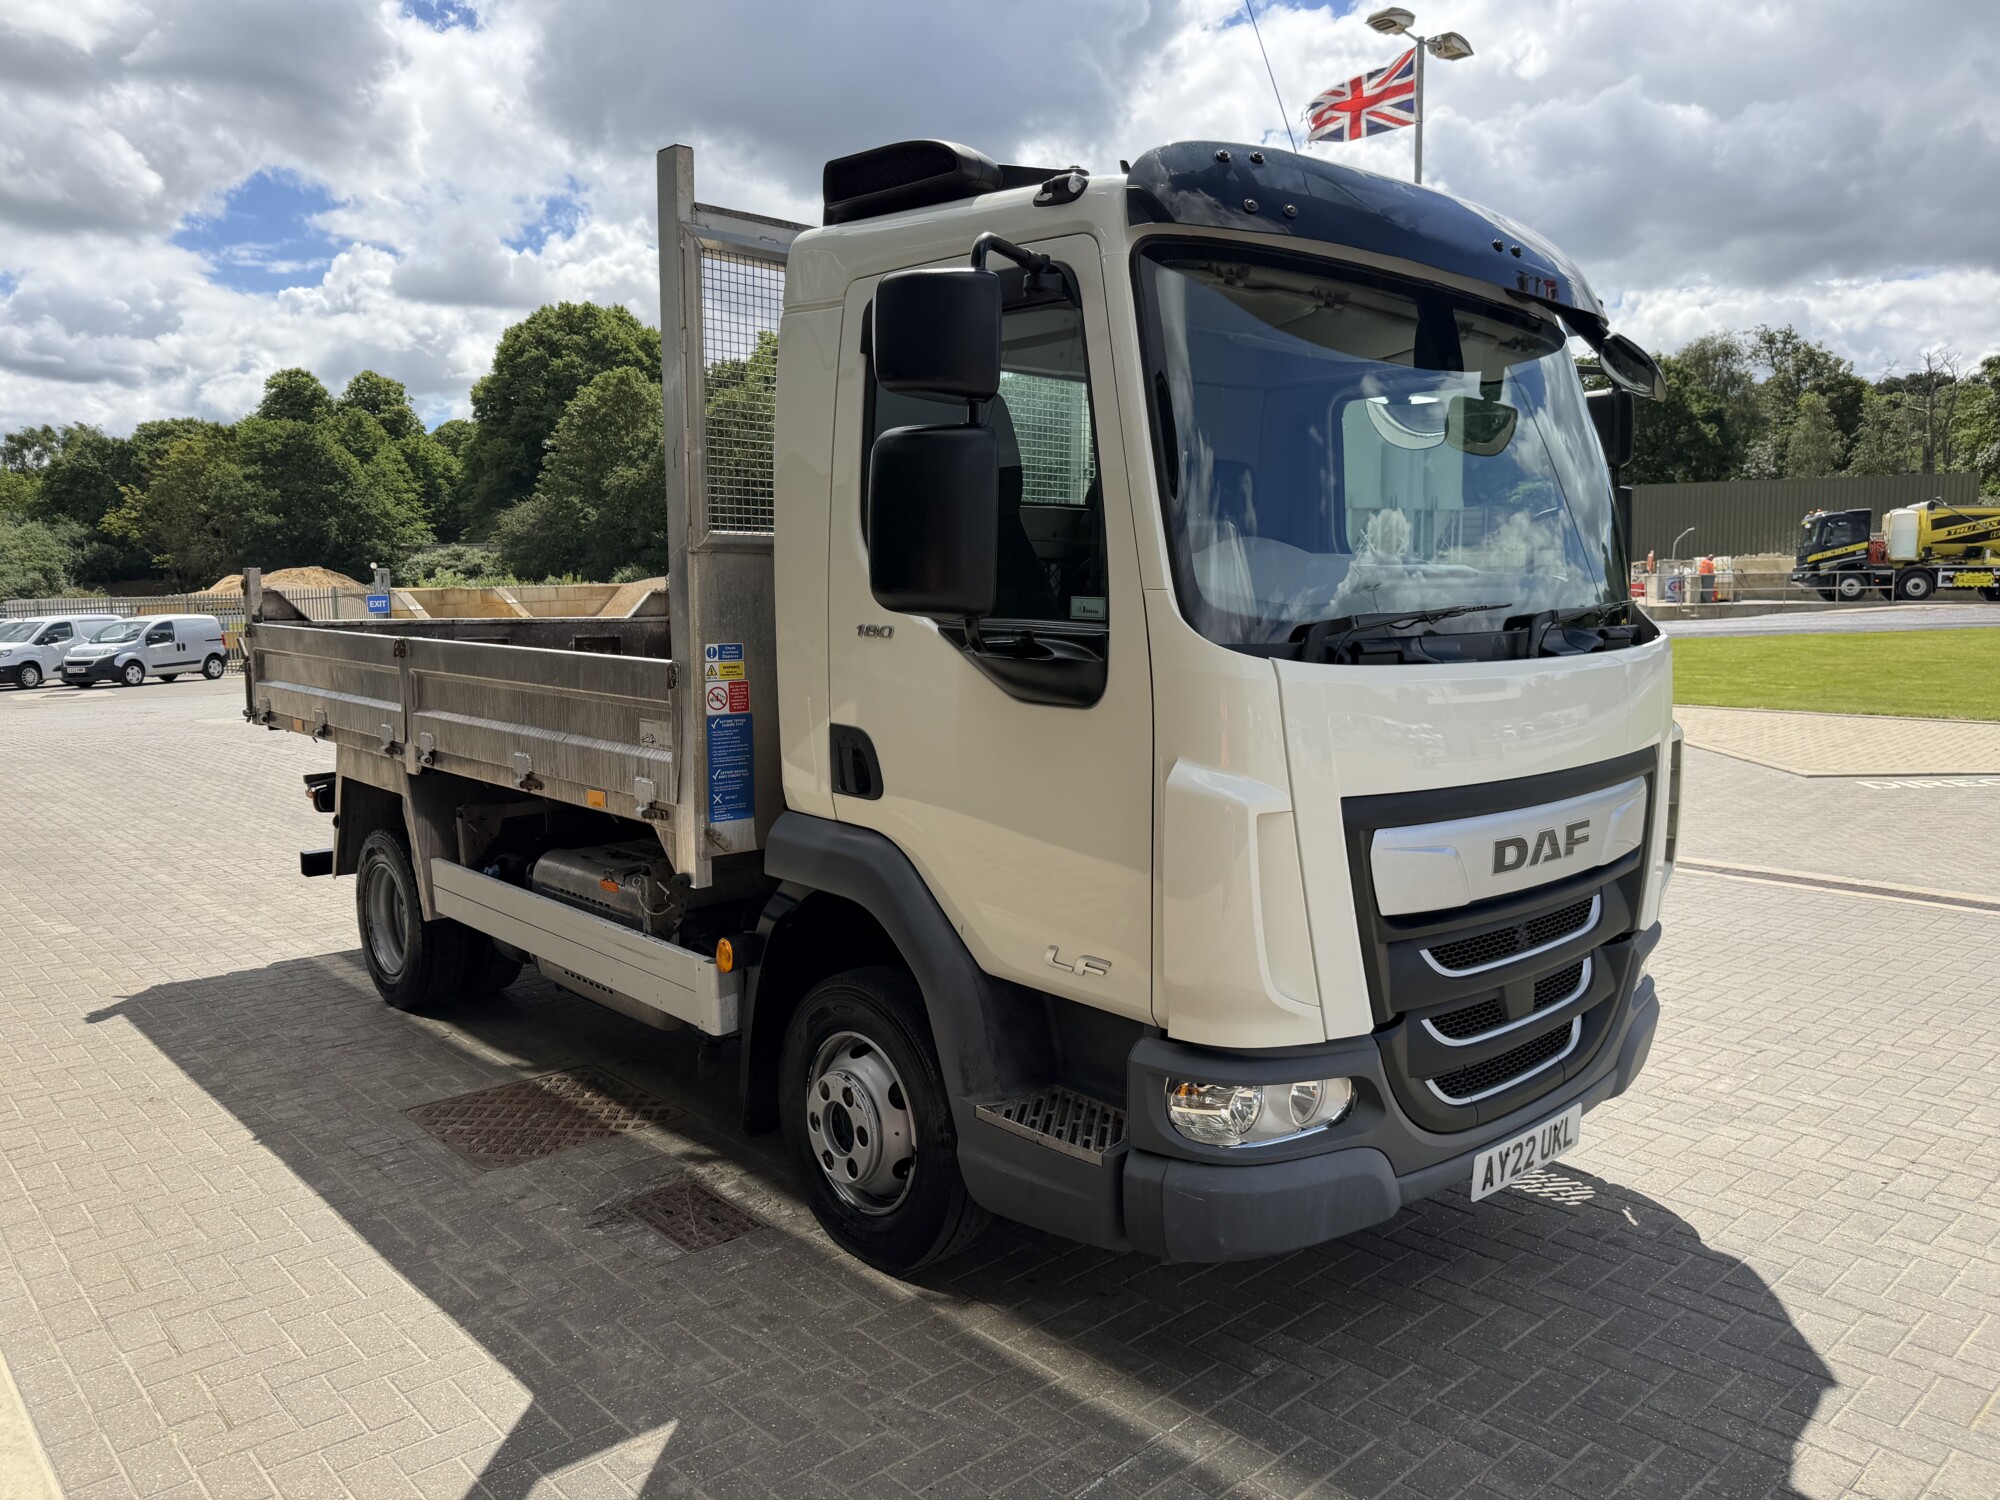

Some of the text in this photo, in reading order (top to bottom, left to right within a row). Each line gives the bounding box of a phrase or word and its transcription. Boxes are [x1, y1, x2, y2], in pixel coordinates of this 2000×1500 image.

[369, 600, 387, 608] EXIT
[856, 623, 895, 640] 180
[1491, 816, 1590, 876] DAF
[1043, 944, 1117, 976] LF
[1481, 1116, 1573, 1192] AY22 UKL
